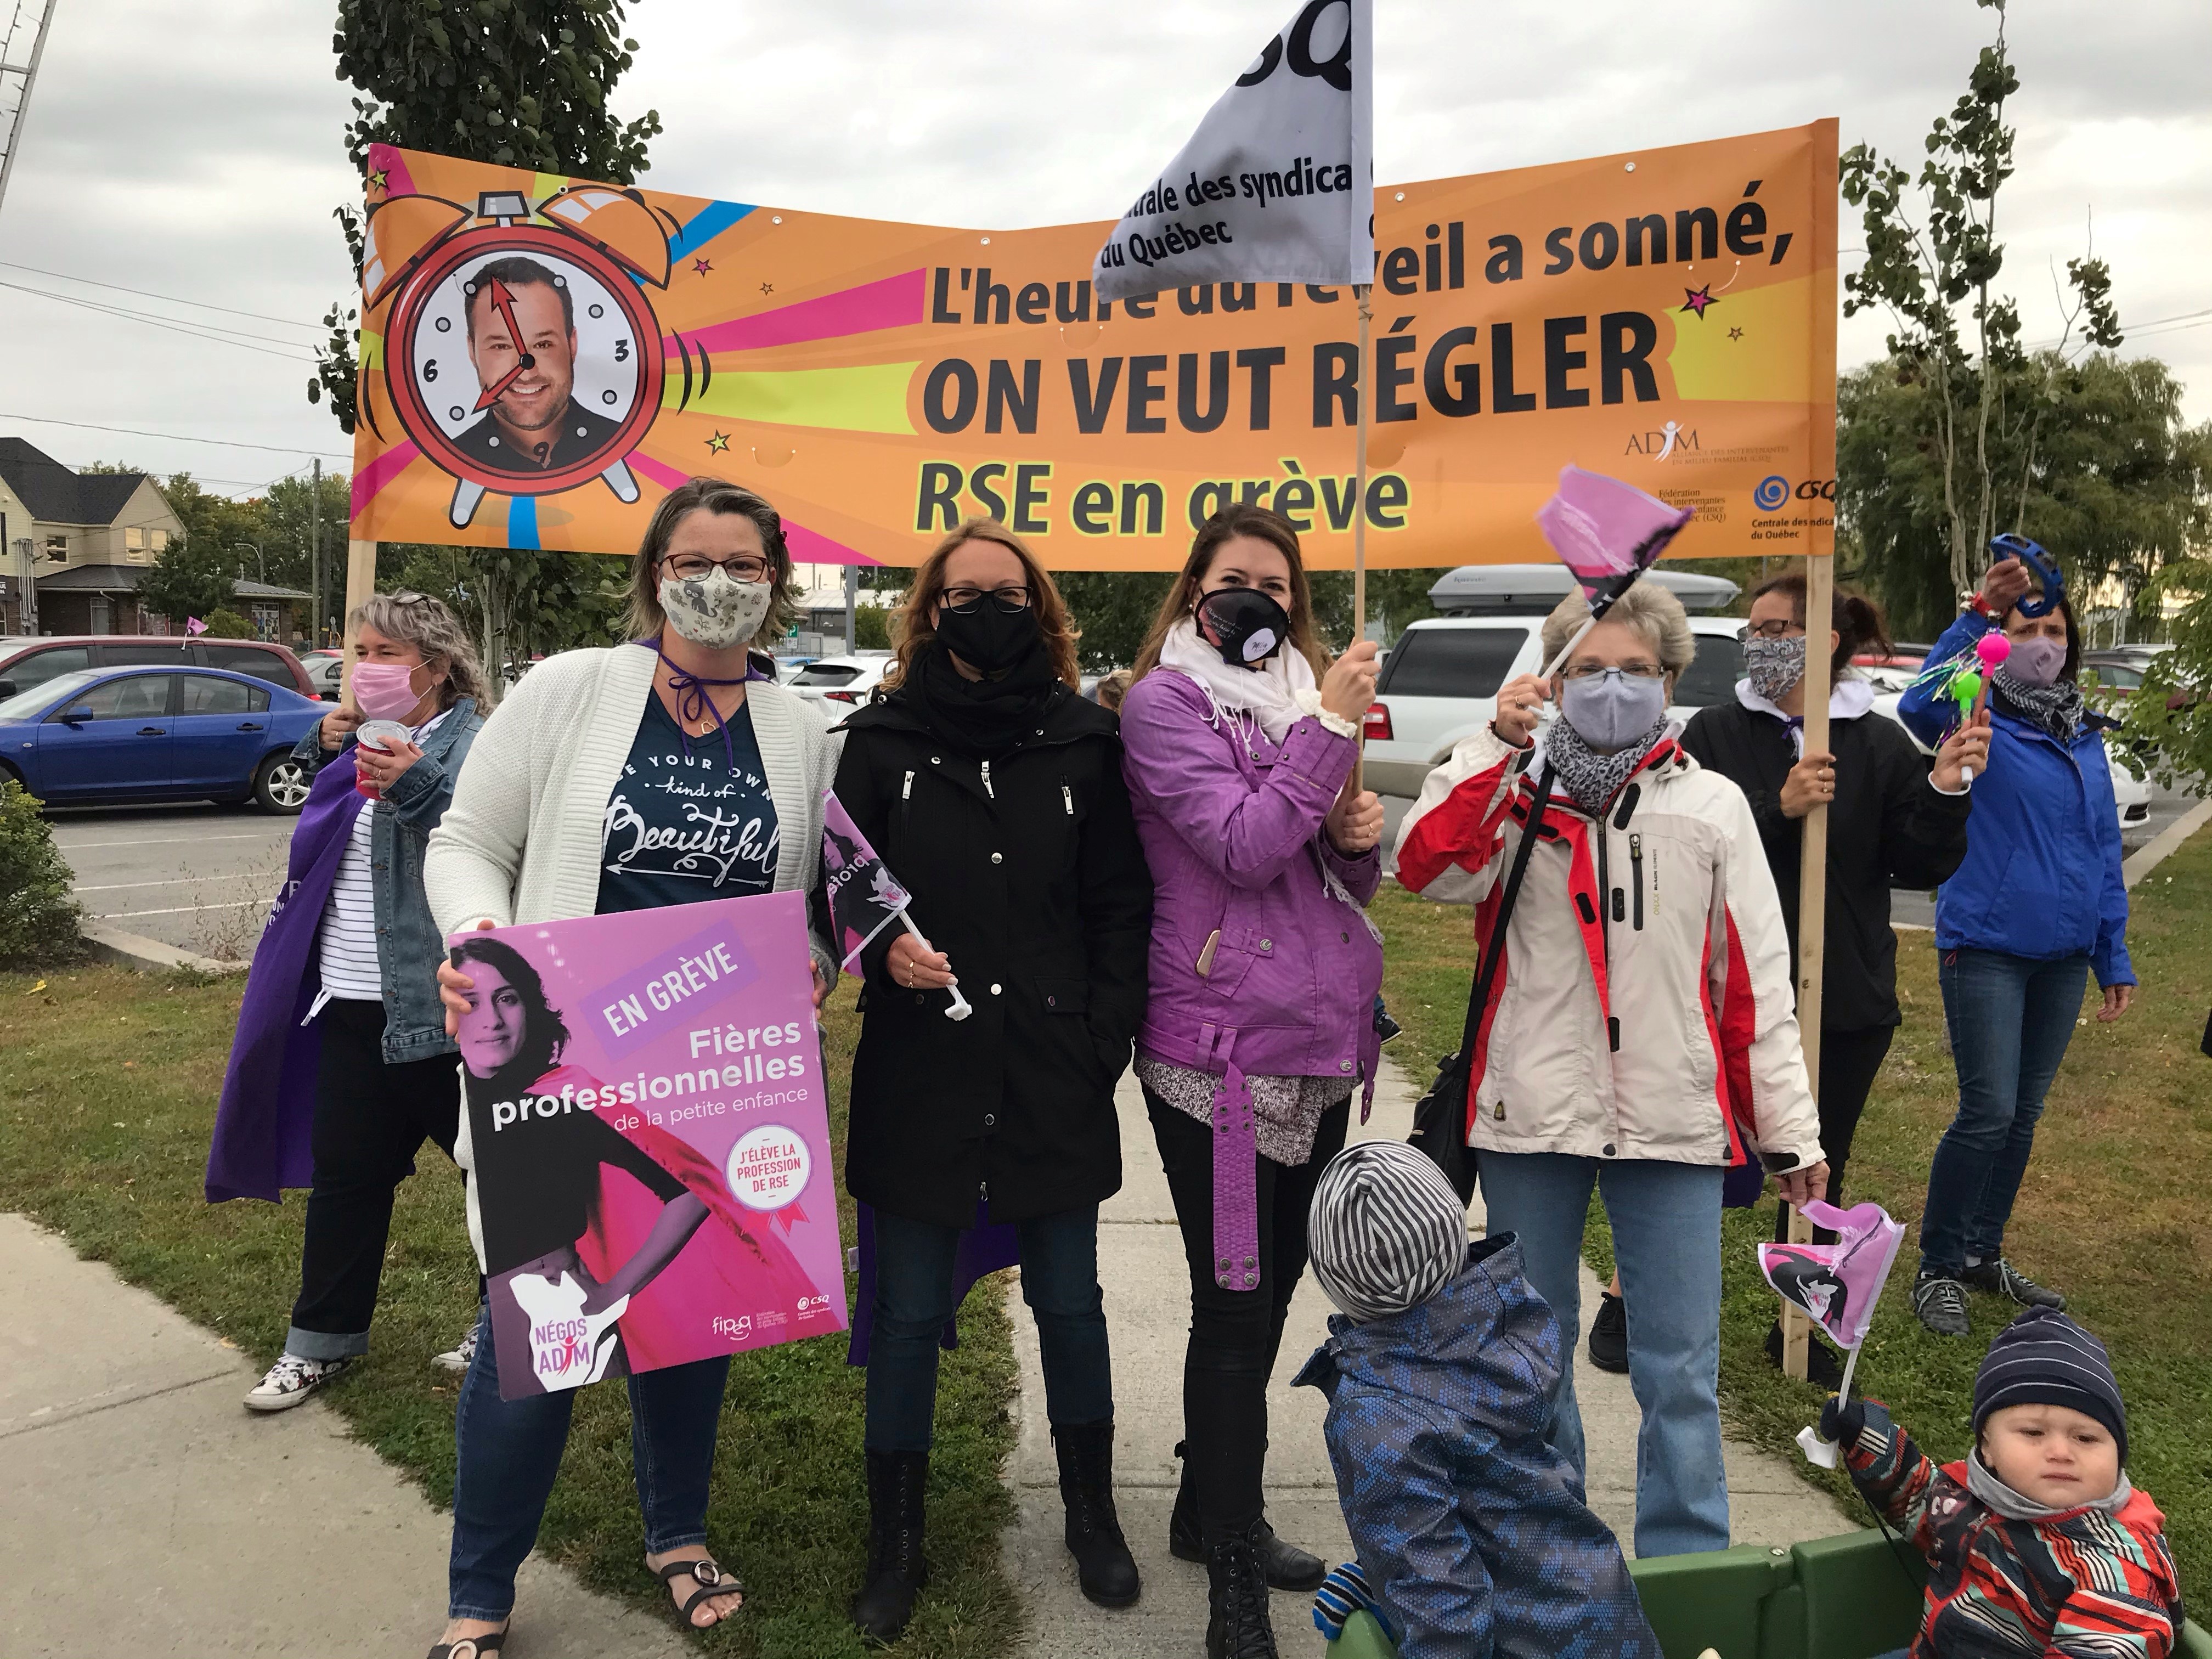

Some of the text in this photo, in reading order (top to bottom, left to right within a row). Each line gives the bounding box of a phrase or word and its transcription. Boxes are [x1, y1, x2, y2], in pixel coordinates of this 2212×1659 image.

[1184, 172, 1235, 207] des
[1101, 221, 1233, 268] du Québec
[1177, 281, 1256, 316] du
[1485, 234, 1523, 284] a
[1544, 179, 1793, 276] sonné,
[923, 310, 1661, 435] ON VEUT RÉGLER
[914, 456, 1412, 538] RSE en grève
[1658, 488, 1701, 498] Fédération
[1674, 497, 1726, 506] intervenantes
[1702, 513, 1726, 523] (CSQ)
[1752, 518, 1790, 528] Centrale
[1792, 517, 1808, 526] des
[1751, 529, 1800, 540] du Québec
[648, 755, 712, 770] YOUR
[656, 775, 737, 798] kind of
[601, 794, 781, 888] Beautiful
[602, 941, 738, 1037] EN GRÈVE
[690, 1022, 802, 1059] Fières
[492, 1053, 805, 1132] professionnelles
[614, 1088, 808, 1132] de la petite enfance
[740, 1143, 796, 1164] J'ÉLÈVE LA
[737, 1157, 801, 1180] PROFESSION
[753, 1175, 789, 1192] DE RSE
[810, 1294, 830, 1305] CSQ
[534, 1318, 588, 1345] NÉGOS
